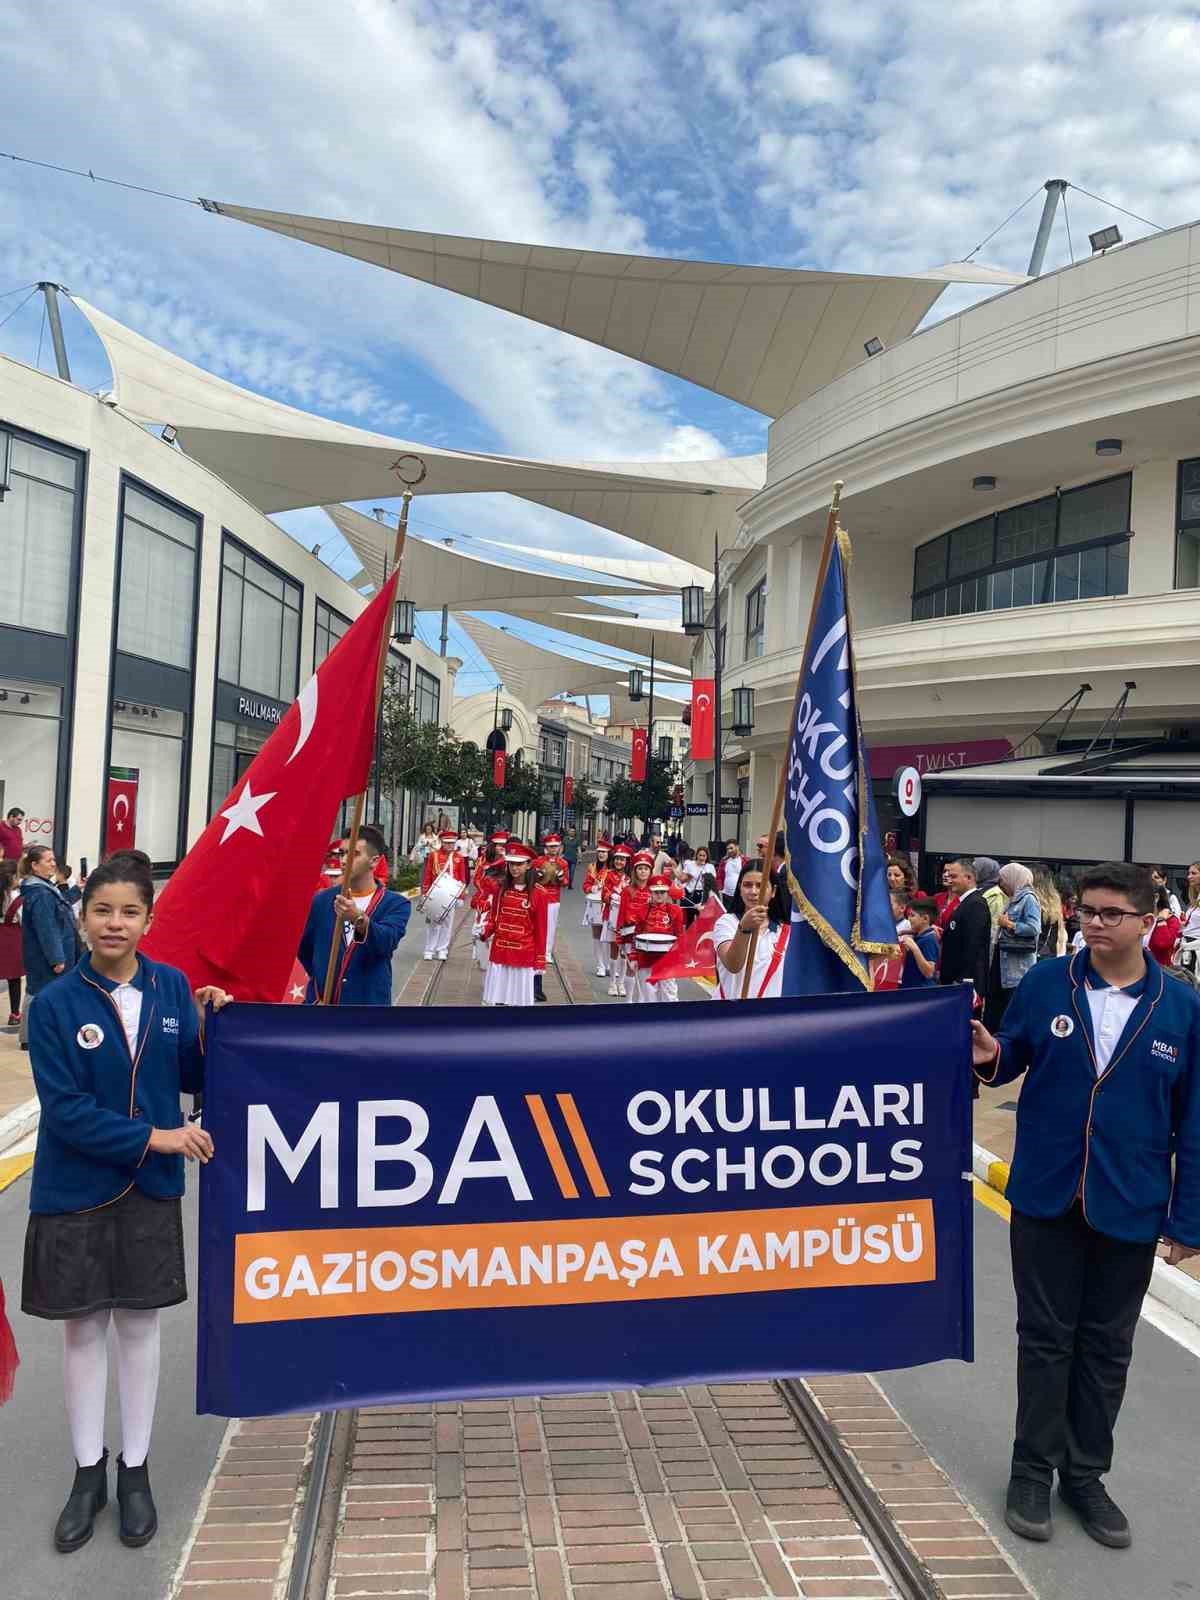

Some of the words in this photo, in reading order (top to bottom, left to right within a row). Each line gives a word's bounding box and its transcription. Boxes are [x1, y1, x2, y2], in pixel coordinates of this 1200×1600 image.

[916, 752, 967, 771] TWIST
[1152, 1040, 1173, 1056] MBA
[626, 1083, 925, 1136] OKULLARI
[628, 1139, 924, 1196] SCHOOLS
[698, 1212, 924, 1275] KAMPÜSÜ
